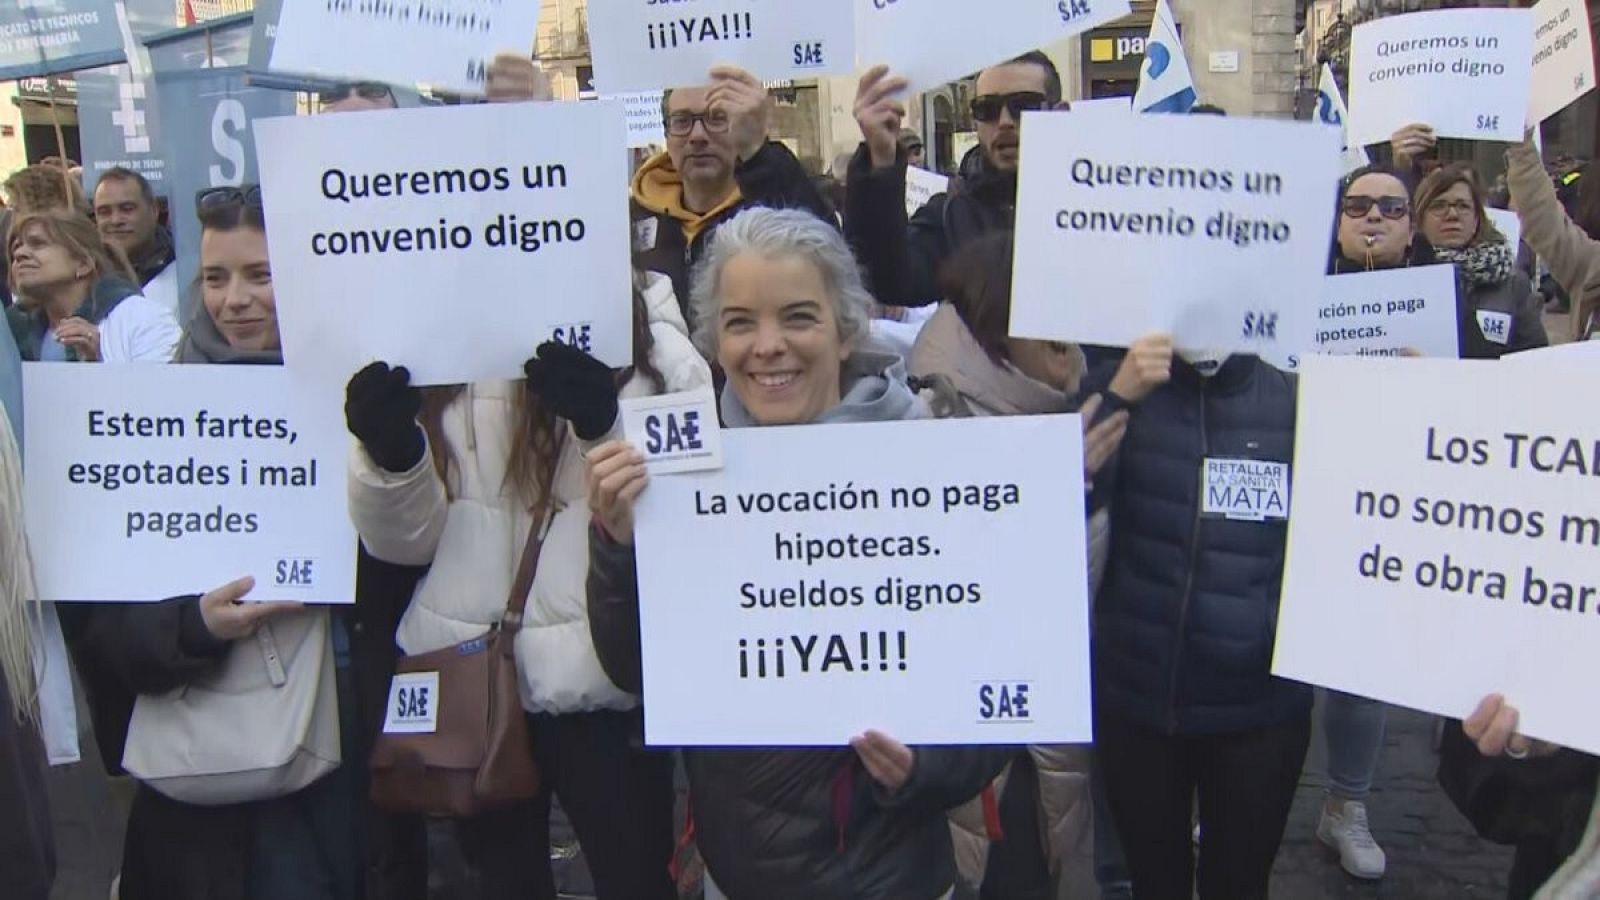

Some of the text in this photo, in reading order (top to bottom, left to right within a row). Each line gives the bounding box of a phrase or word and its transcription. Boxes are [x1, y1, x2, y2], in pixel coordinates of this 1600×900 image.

[794, 42, 823, 65] SAE
[1376, 34, 1499, 57] Queremos un
[1368, 58, 1505, 83] convenio digno
[1476, 114, 1500, 131] SAE
[321, 162, 567, 203] Queremos un
[1071, 158, 1282, 195] Queremos un
[311, 213, 586, 256] convenio digno
[1055, 208, 1291, 246] convenio digno
[1361, 303, 1382, 316] no
[1387, 298, 1425, 315] paga
[88, 410, 298, 444] Estem fartes,
[1426, 427, 1489, 466] Los
[67, 458, 317, 490] esgotades i mal
[1208, 463, 1282, 477] RETALLAR
[695, 482, 1020, 515] La vocación no paga
[1208, 486, 1283, 511] MATA
[1355, 490, 1401, 520] no
[1411, 496, 1545, 539] somos
[126, 505, 259, 538] pagades
[775, 532, 941, 565] hipotecas.
[275, 559, 313, 585] SAE
[1358, 543, 1600, 615] de obra bar
[740, 577, 981, 612] Sueldos dignos
[738, 630, 908, 679] ¡¡¡YA!!!
[398, 688, 429, 717] SAE
